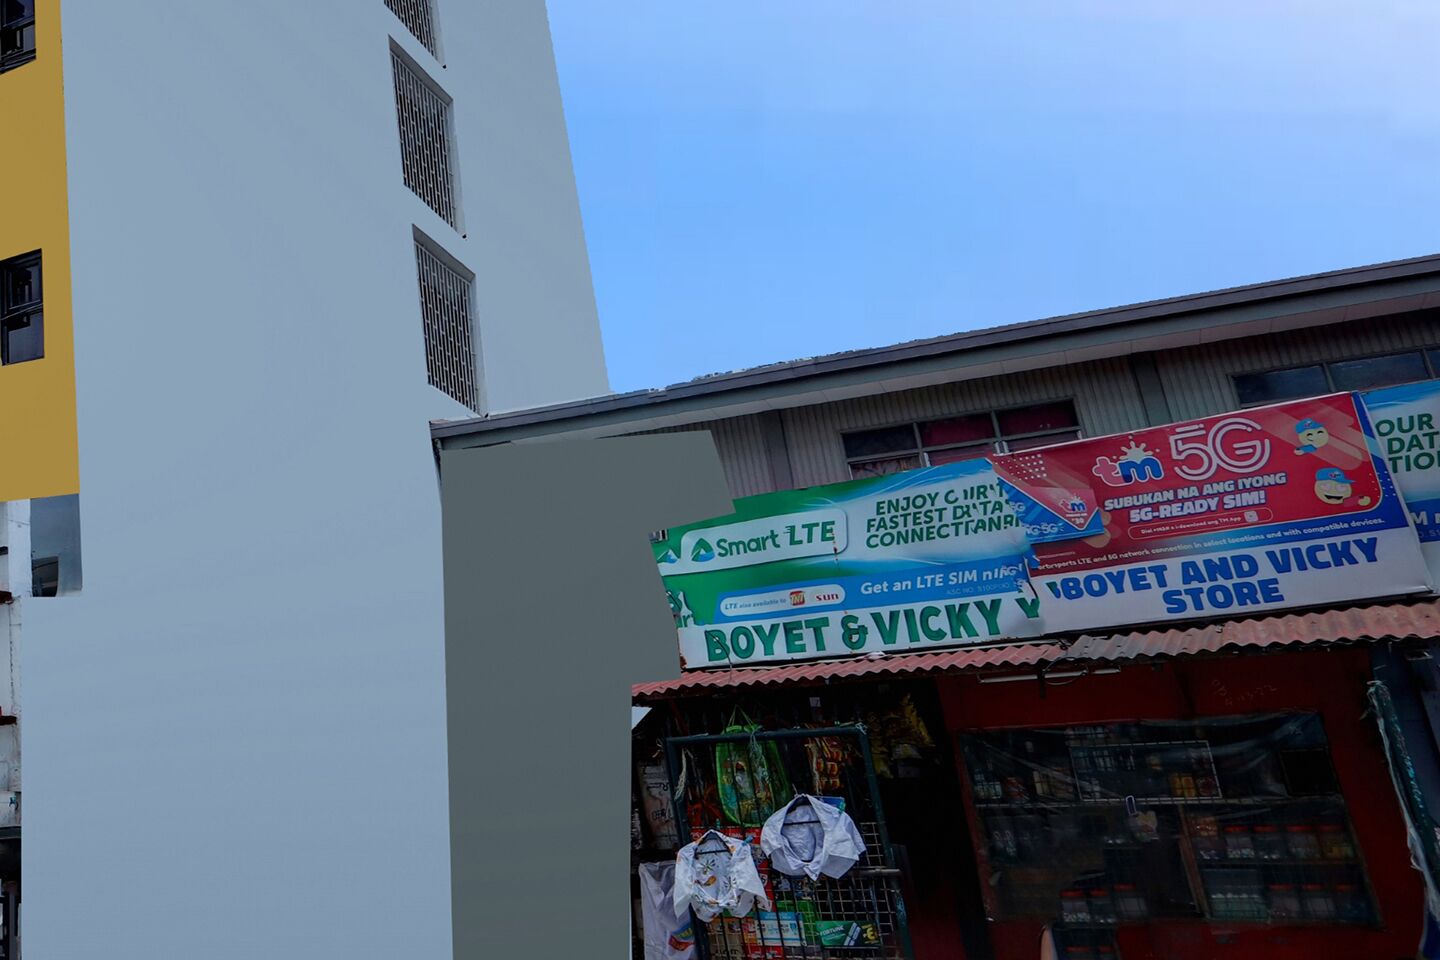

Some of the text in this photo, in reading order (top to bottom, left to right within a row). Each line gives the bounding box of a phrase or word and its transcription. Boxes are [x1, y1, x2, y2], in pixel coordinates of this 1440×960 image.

[1375, 412, 1435, 437] OUR
[1092, 417, 1271, 487] tm 5G
[1387, 431, 1440, 454] DAT
[1388, 452, 1440, 474] TIO
[876, 492, 939, 516] ENJOY
[1104, 473, 1287, 511] SUBUKAN NA ANG IYONG
[1129, 490, 1267, 523] 5G-READY SIM!
[866, 507, 947, 532] FASTEST
[716, 520, 836, 558] Smart LTE
[1077, 557, 1092, 565] LTE
[1093, 554, 1107, 563] and
[1119, 548, 1151, 559] network
[1151, 543, 1193, 555] connection
[1194, 541, 1202, 549] in
[1203, 538, 1225, 548] select
[1227, 532, 1264, 544] locations
[1266, 530, 1281, 539] and
[1283, 526, 1302, 536] with
[1302, 521, 1349, 535] compatible
[1350, 517, 1385, 528] devices.
[861, 582, 891, 595] Get
[893, 579, 912, 591] an
[917, 574, 944, 589] LTE
[949, 569, 978, 585] SIM
[1061, 564, 1168, 600] BOYET
[1181, 553, 1258, 586] AND
[1265, 536, 1378, 574] VICKY
[815, 593, 839, 602] sun
[1162, 578, 1285, 614] STORE
[704, 616, 830, 662] BOYET
[841, 614, 868, 650] &
[870, 598, 1002, 645] VICKY
